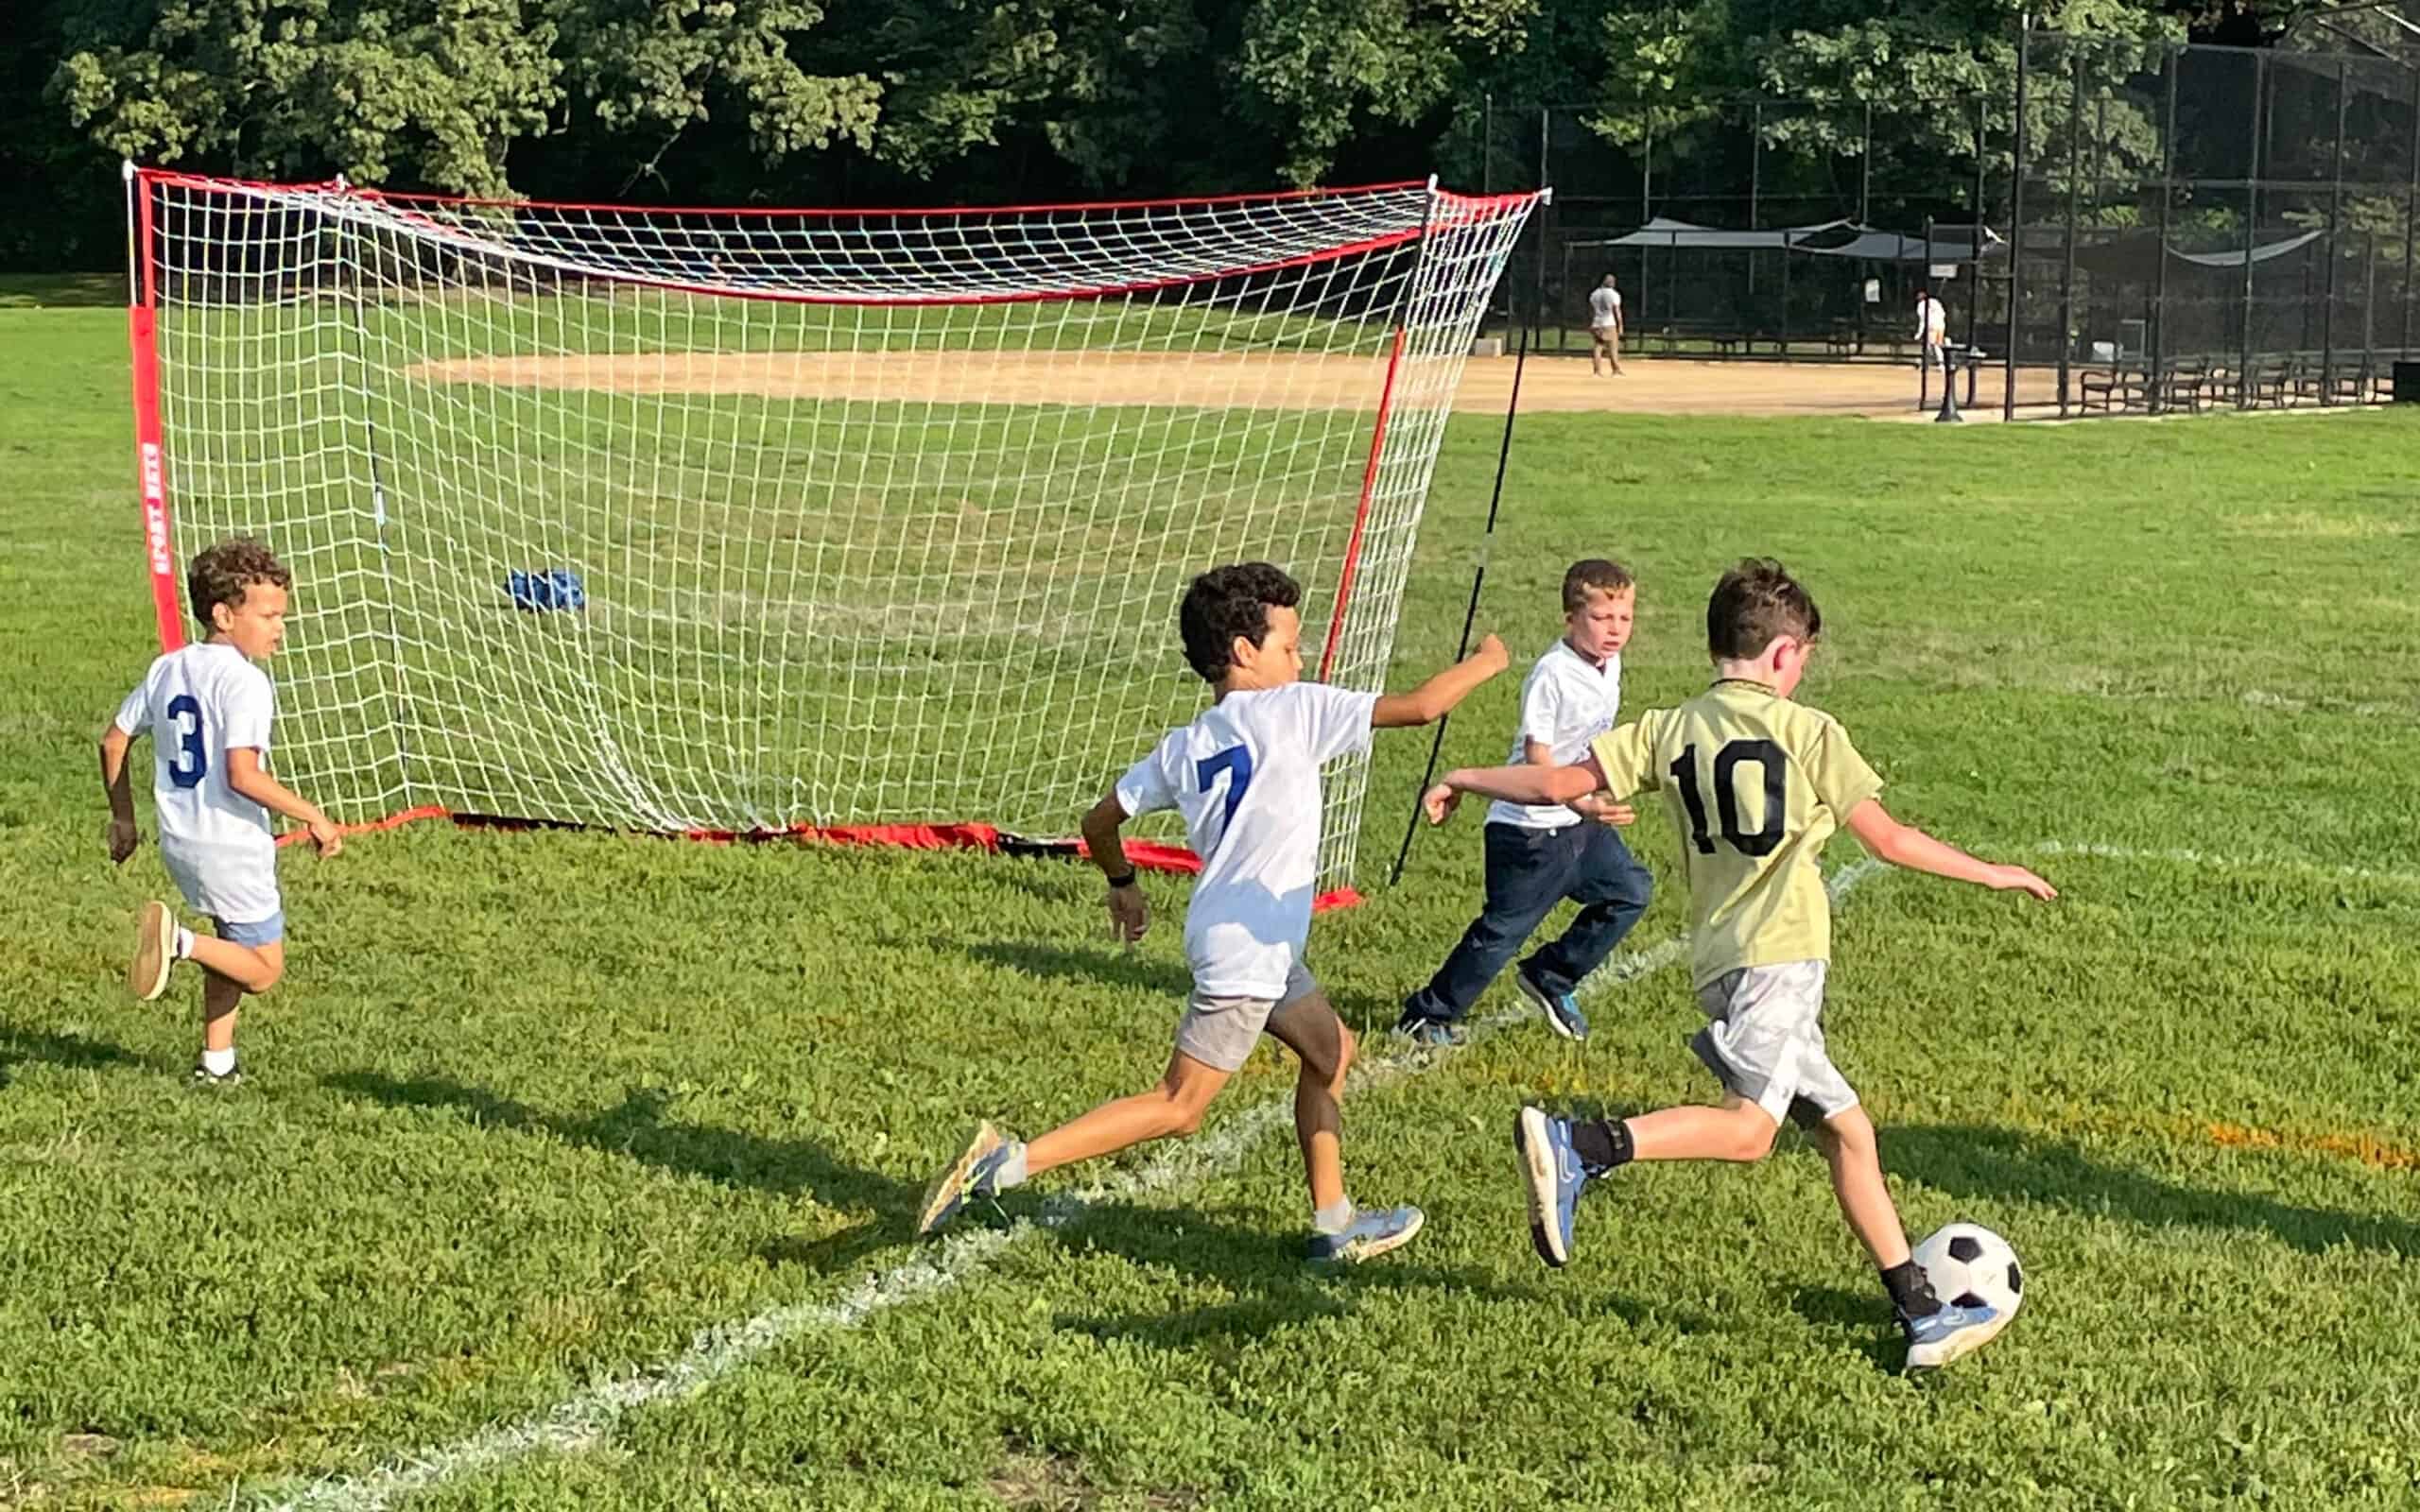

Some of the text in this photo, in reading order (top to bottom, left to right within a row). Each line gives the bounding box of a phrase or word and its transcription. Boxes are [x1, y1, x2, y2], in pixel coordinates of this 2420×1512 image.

[142, 442, 171, 575] SPORT NETS
[167, 694, 207, 788] 3
[1197, 744, 1253, 841] 7
[1670, 740, 1786, 856] 10
